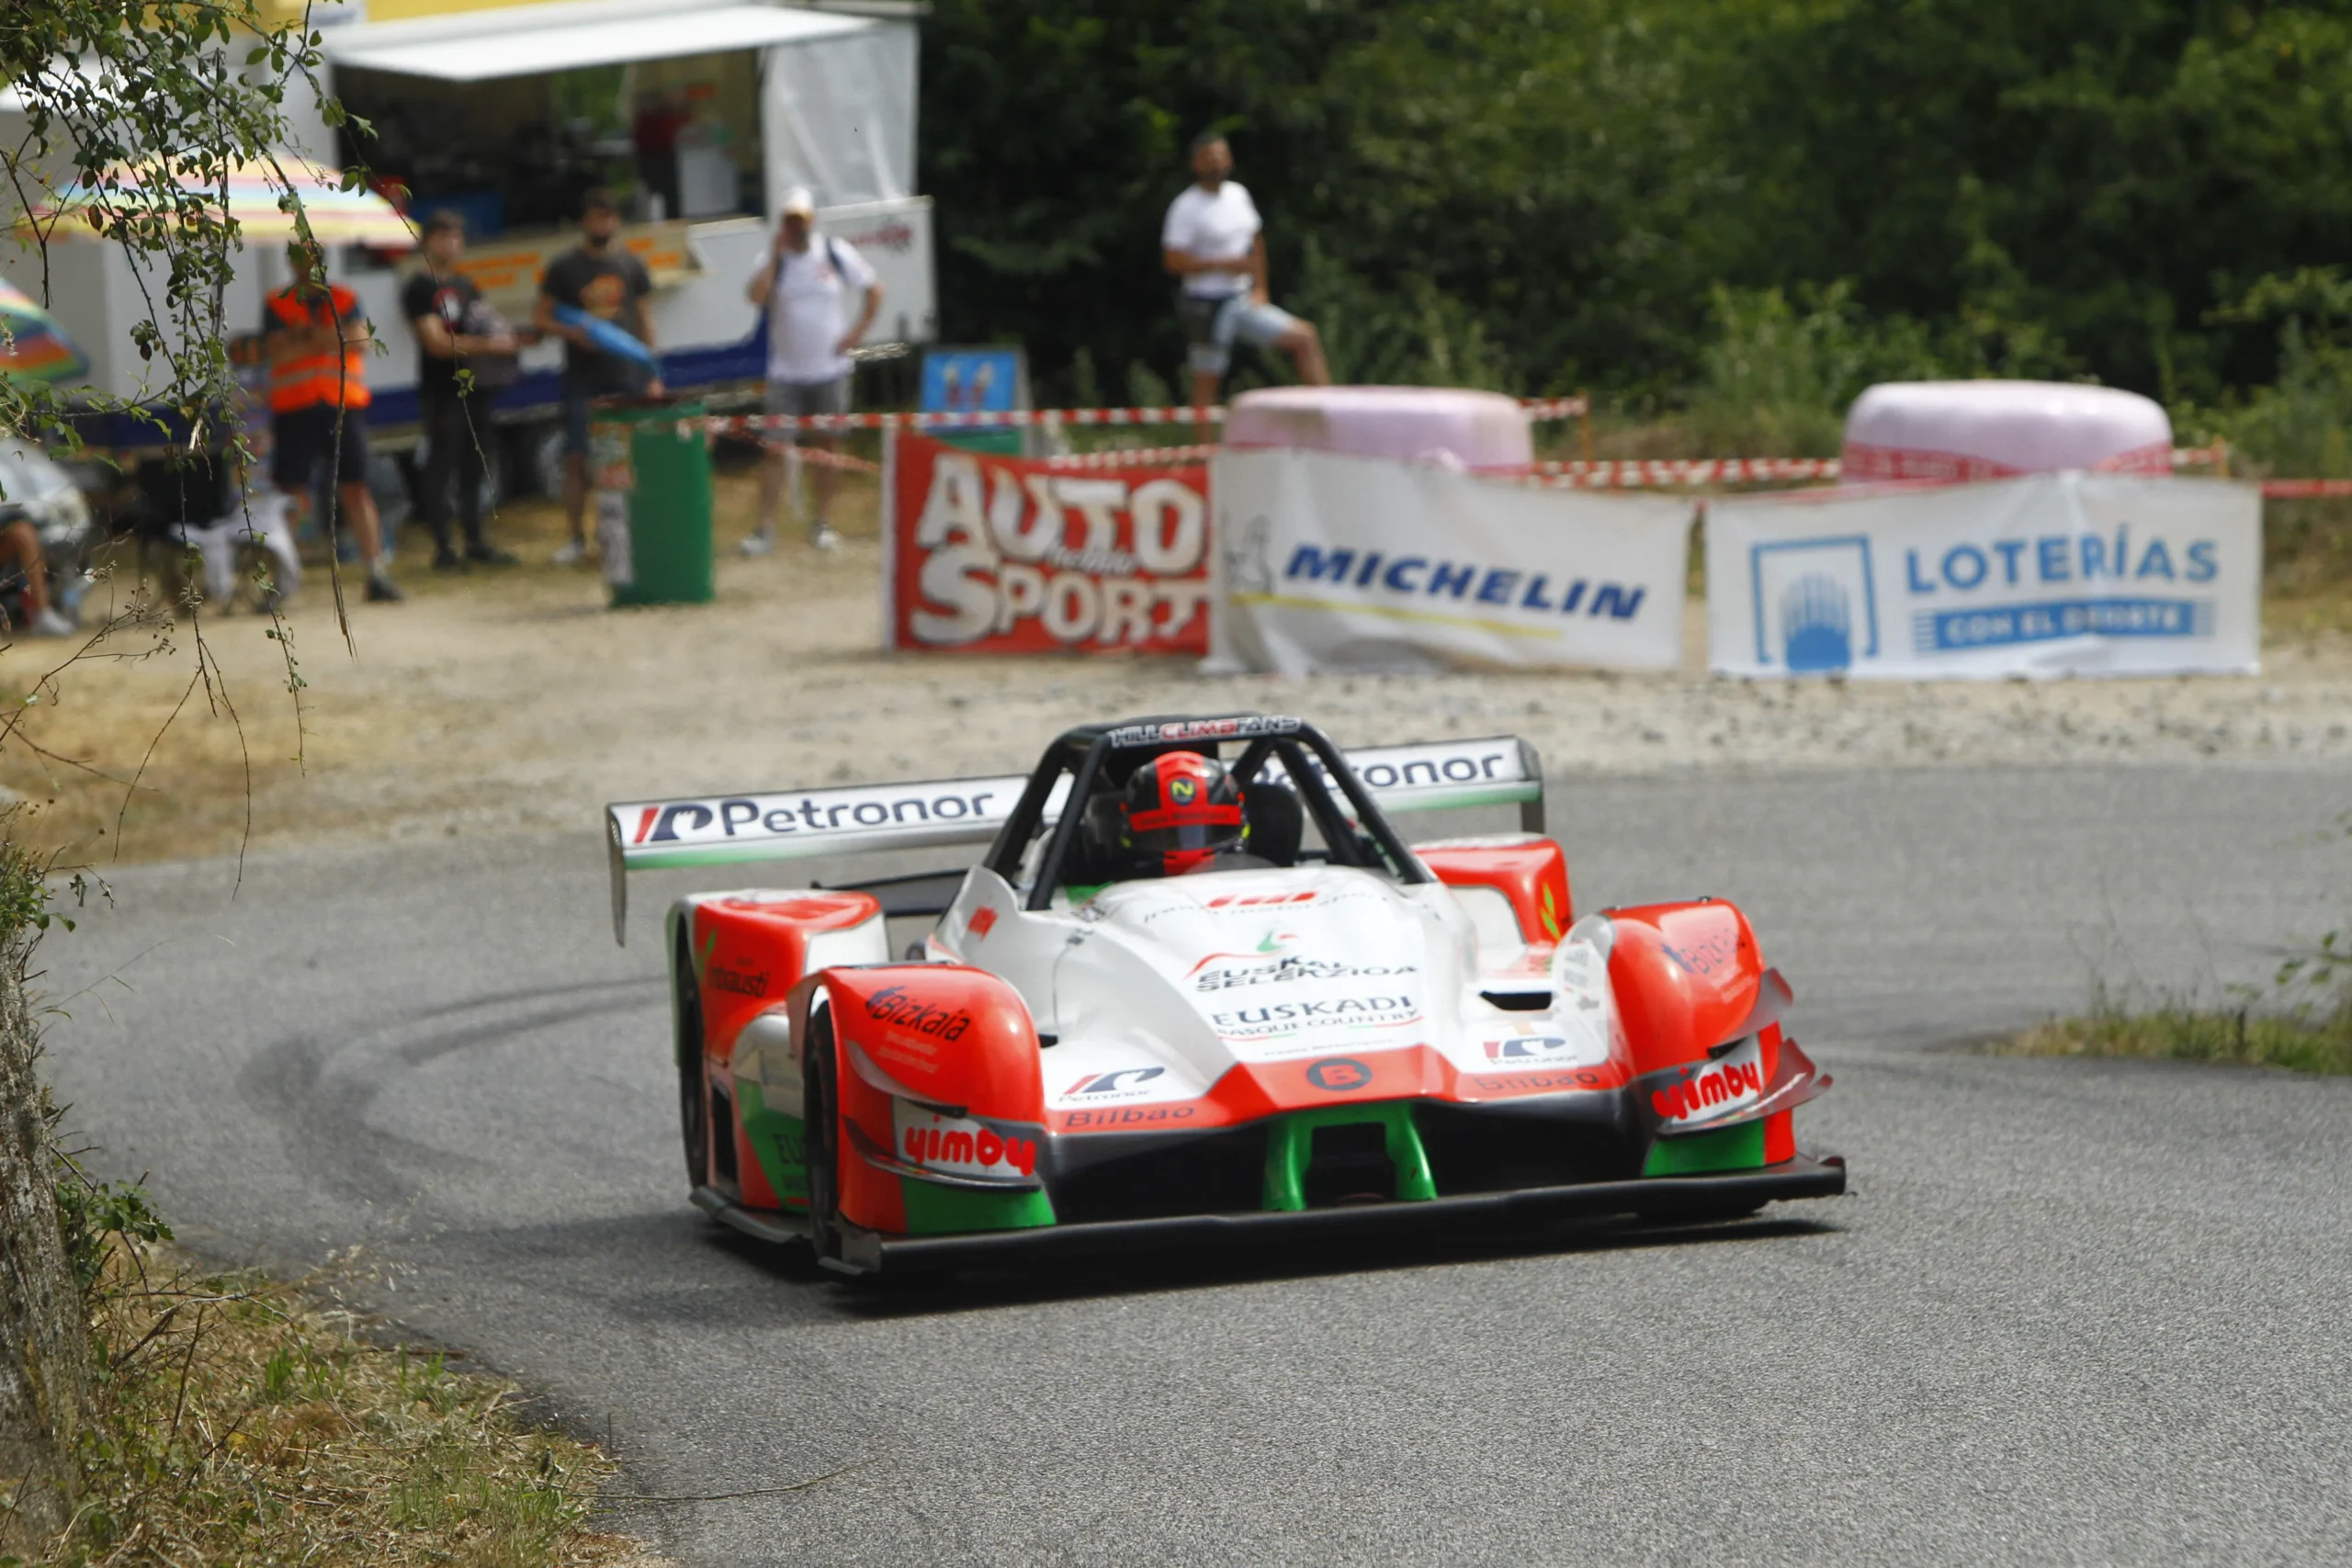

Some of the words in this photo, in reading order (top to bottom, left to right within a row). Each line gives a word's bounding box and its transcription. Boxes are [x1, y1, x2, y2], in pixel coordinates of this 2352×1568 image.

[915, 454, 1205, 576] AUTO
[1905, 523, 2220, 595] LOTERÍAS
[910, 546, 1212, 645] SPORT
[1283, 544, 1645, 622] MICHELIN
[1945, 615, 2015, 645] CON
[720, 793, 994, 836] Petronor
[870, 995, 970, 1042] Bizkaia
[1212, 996, 1412, 1026] EUSKADI
[1066, 1107, 1194, 1127] Bilbao
